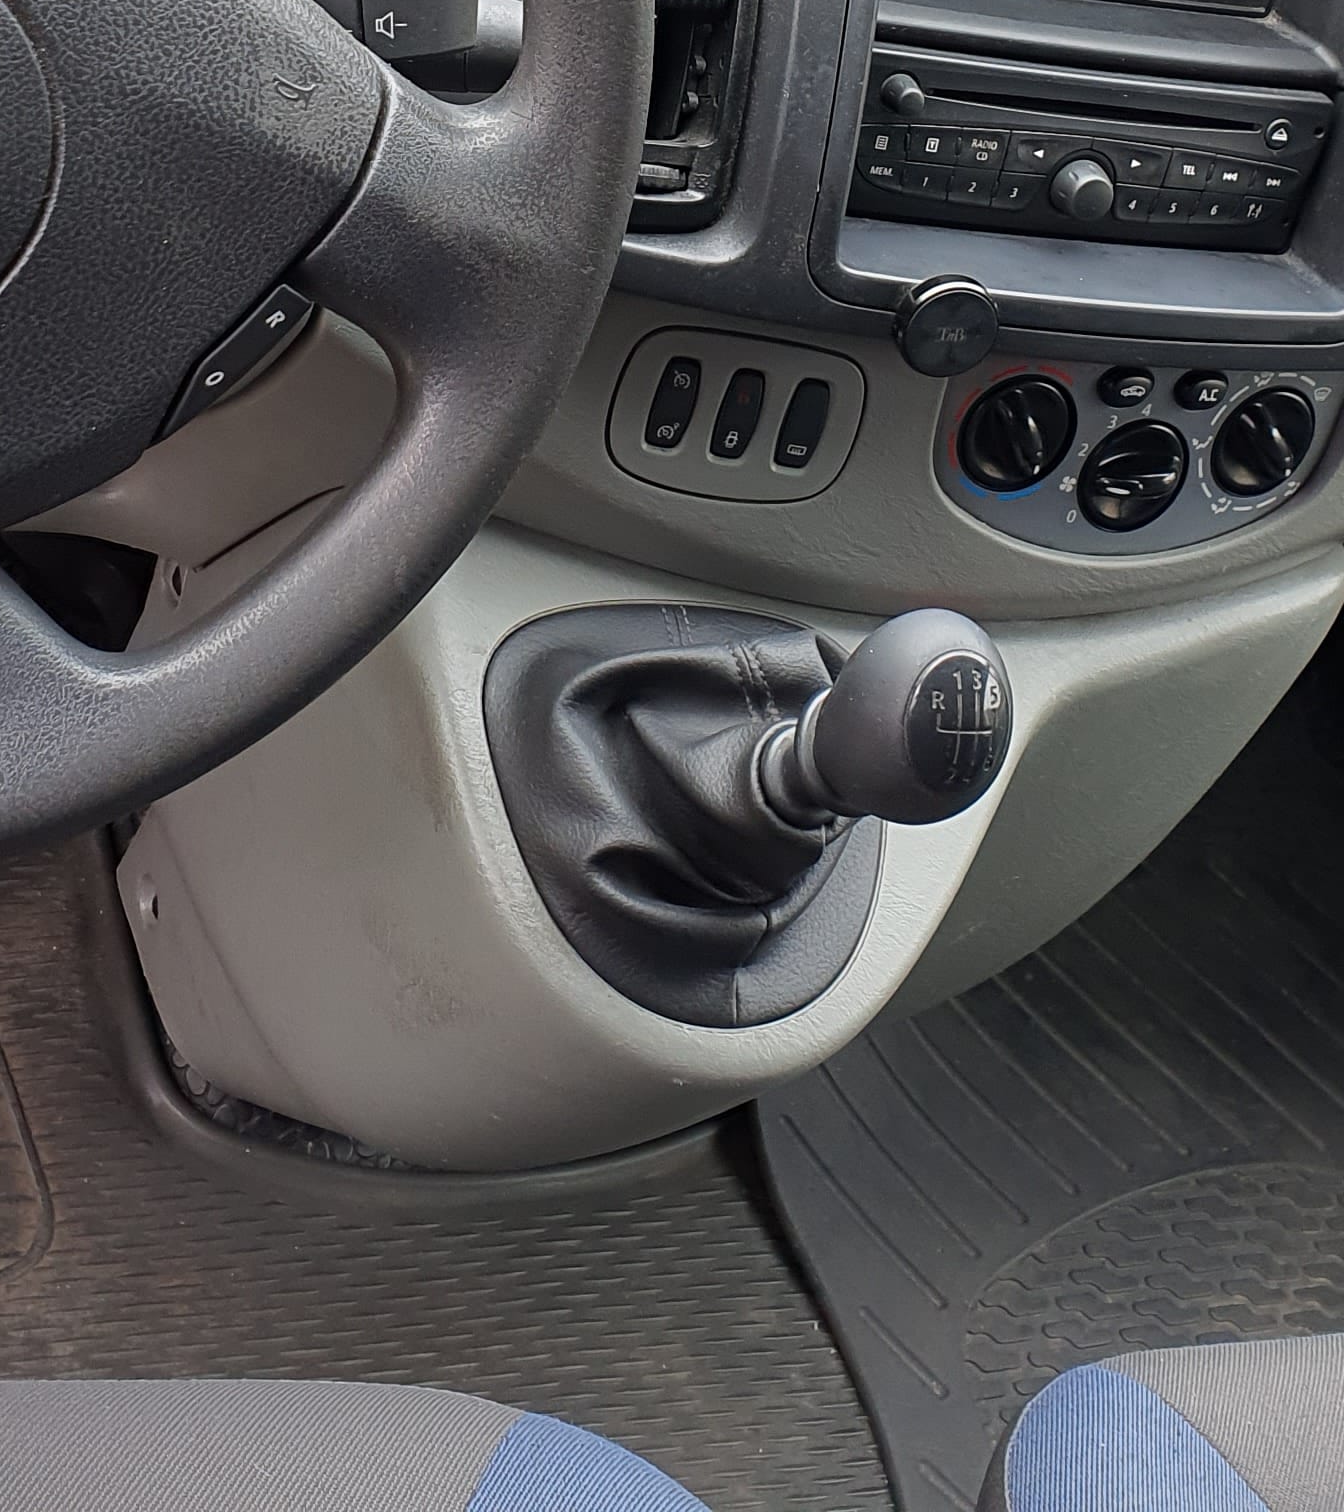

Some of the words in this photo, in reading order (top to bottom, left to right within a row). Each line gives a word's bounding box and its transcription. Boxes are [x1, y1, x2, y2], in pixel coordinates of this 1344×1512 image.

[970, 138, 999, 151] RADIO
[975, 151, 989, 161] CD
[1182, 164, 1197, 176] TEL
[922, 176, 929, 187] 1
[967, 181, 978, 193] 2
[1009, 187, 1020, 199] 3
[1127, 199, 1138, 210] 4
[1168, 202, 1179, 213] 5
[1210, 204, 1220, 216] 6
[265, 310, 286, 328] R
[1141, 403, 1153, 417] 4
[1107, 415, 1119, 429] 3
[1077, 443, 1089, 457] 2
[1066, 509, 1077, 523] 0
[952, 670, 963, 690] 1
[971, 669, 983, 690] 3
[931, 691, 946, 711] R
[989, 685, 999, 707] 5
